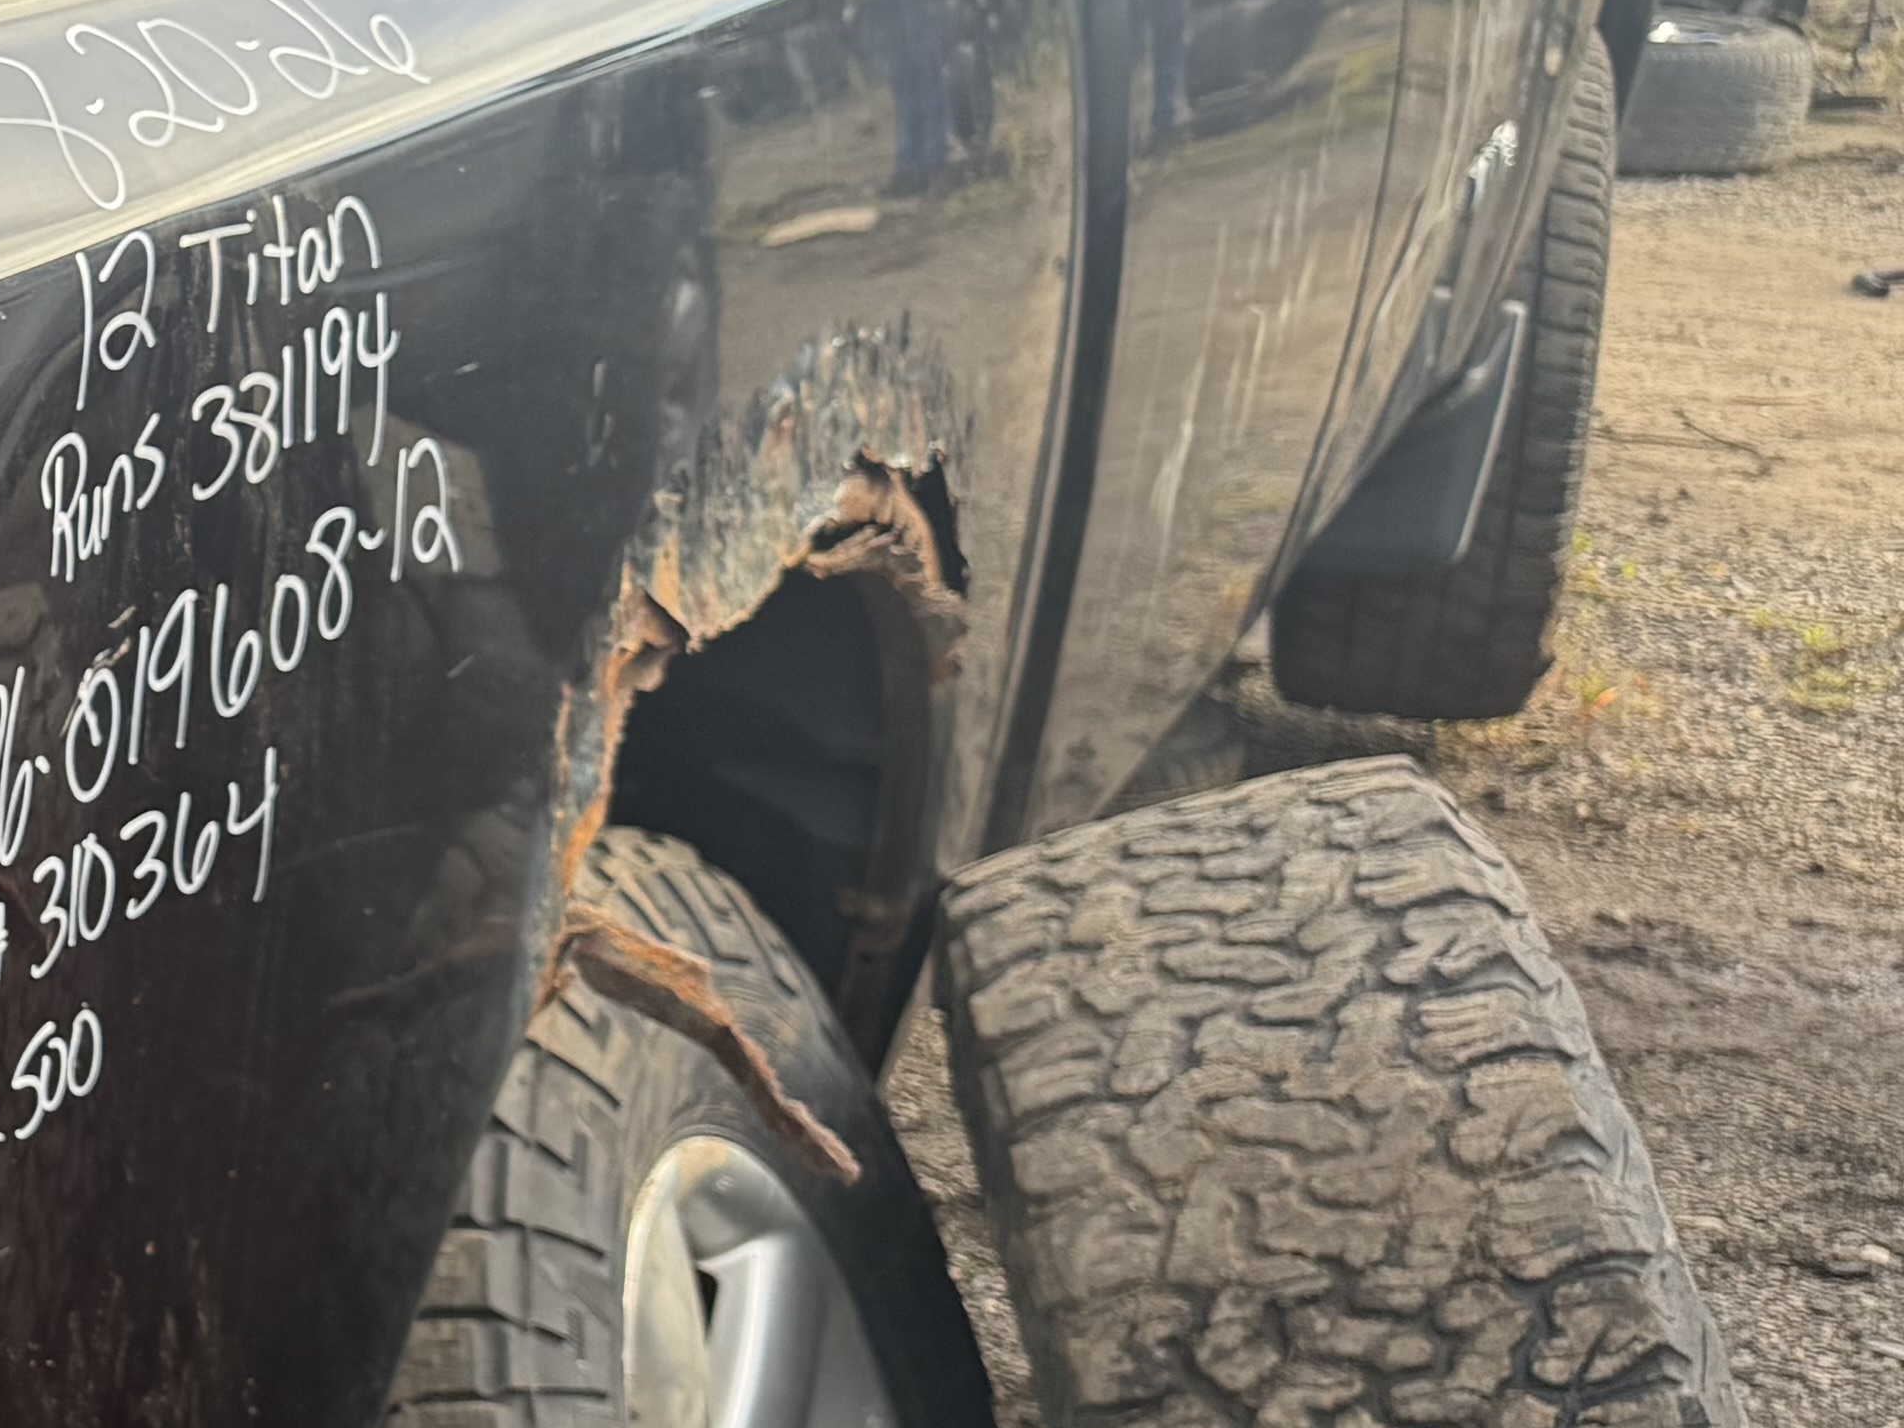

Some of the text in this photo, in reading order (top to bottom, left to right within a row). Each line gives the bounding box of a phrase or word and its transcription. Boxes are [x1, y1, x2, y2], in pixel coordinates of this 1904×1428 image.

[75, 194, 382, 411] 12 Titan
[40, 291, 401, 584] Runs 381194
[29, 746, 280, 980] 310364
